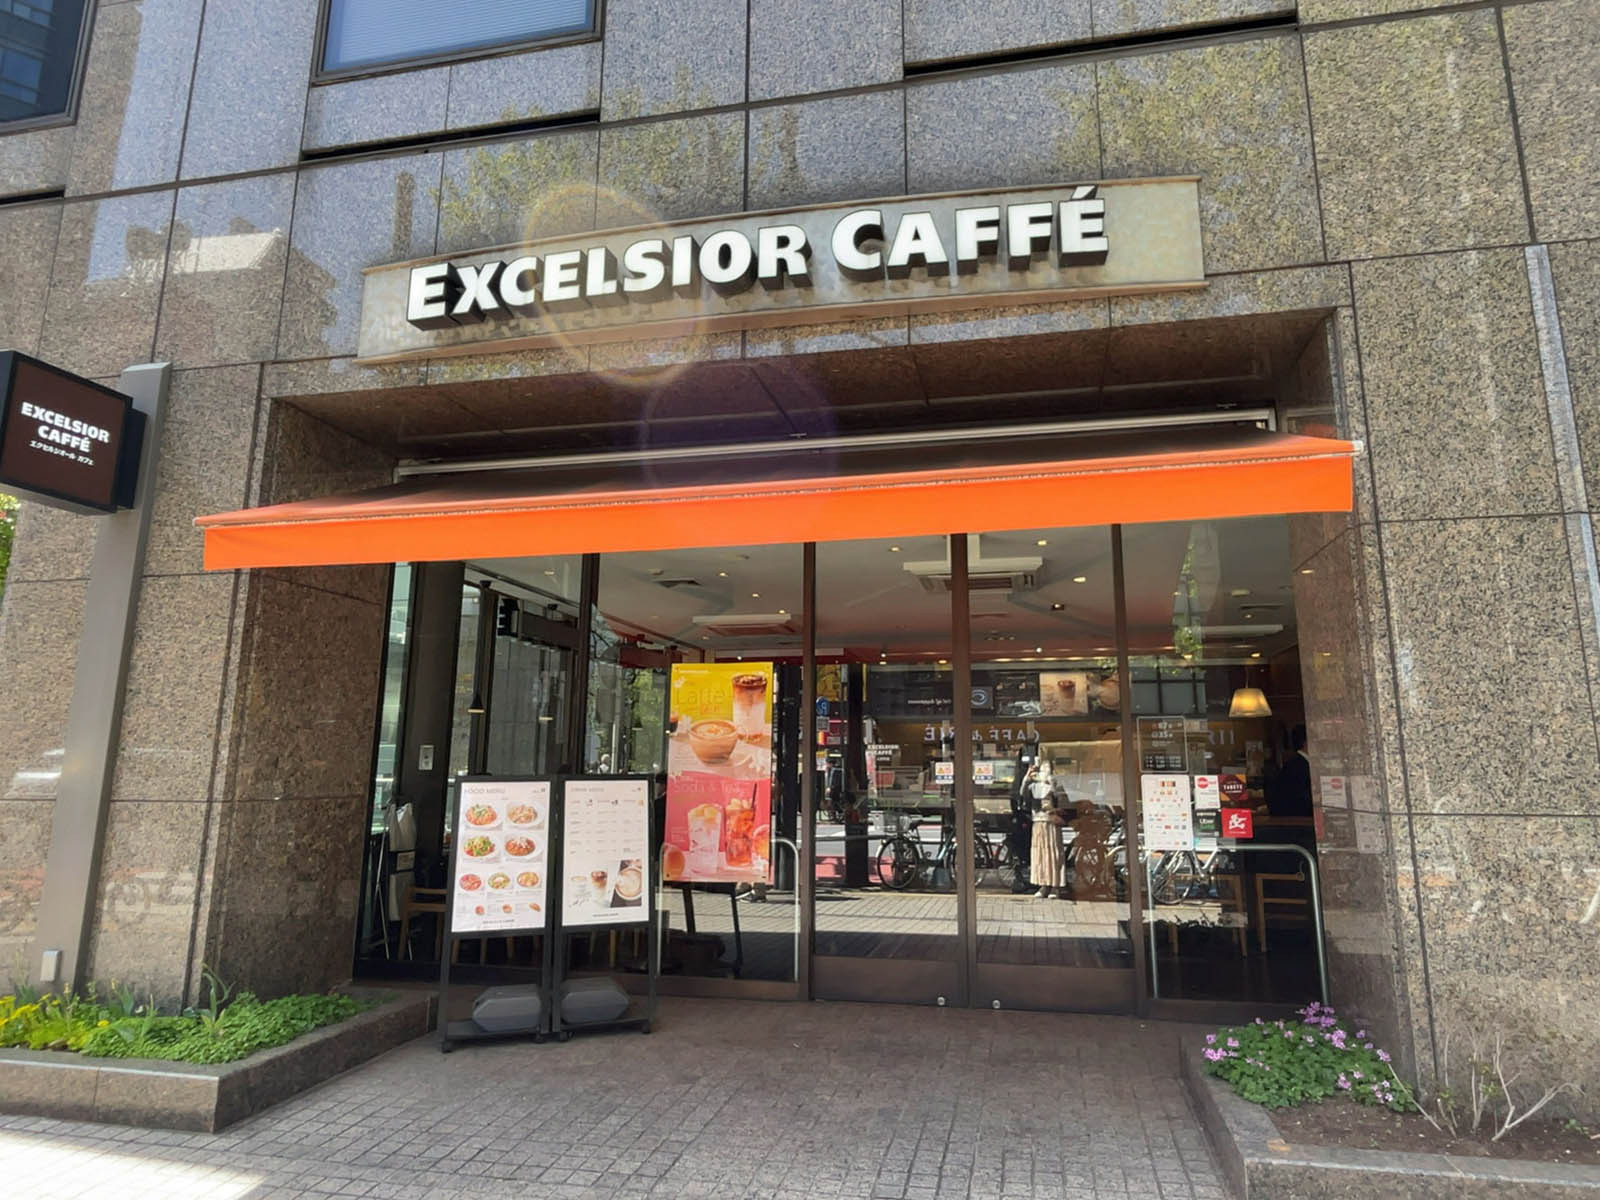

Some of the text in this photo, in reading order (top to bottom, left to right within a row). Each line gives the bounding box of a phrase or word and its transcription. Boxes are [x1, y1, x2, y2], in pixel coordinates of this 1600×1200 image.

[407, 185, 1110, 324] EXCELSIOR CAFFÉ
[20, 401, 110, 443] EXCELSIOR
[38, 425, 91, 453] CAFFÉ
